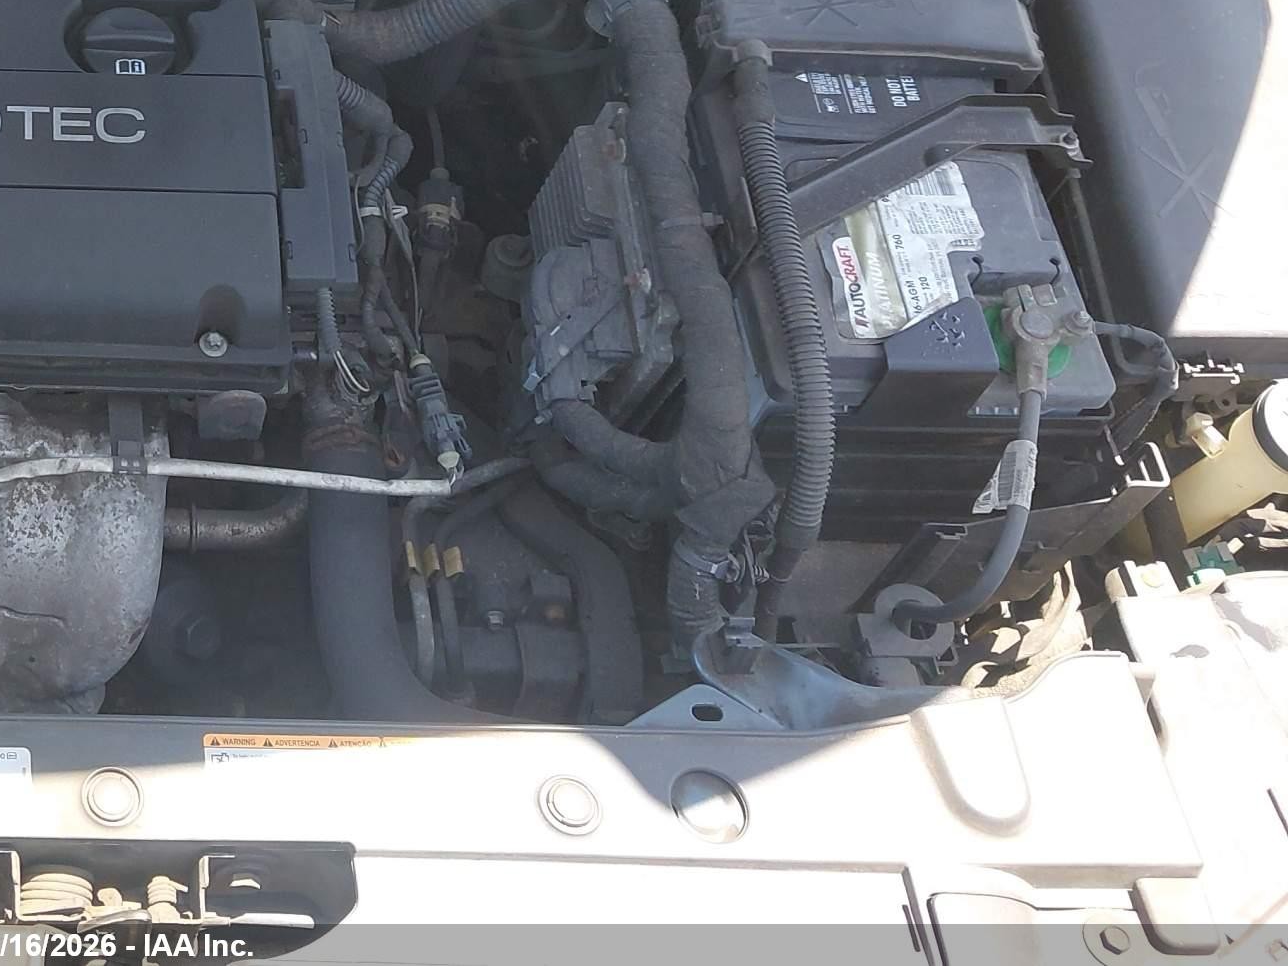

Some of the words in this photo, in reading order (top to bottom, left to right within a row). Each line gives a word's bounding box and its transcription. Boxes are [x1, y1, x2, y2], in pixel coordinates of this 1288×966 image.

[885, 78, 903, 94] NOT
[892, 96, 907, 106] DO
[892, 234, 904, 249] 760
[837, 246, 868, 319] AUTOCRAFT
[919, 277, 931, 290] 120
[865, 252, 896, 328] PLATINUM
[222, 738, 256, 746] WARNING
[275, 739, 320, 747] ADVERTENCIA
